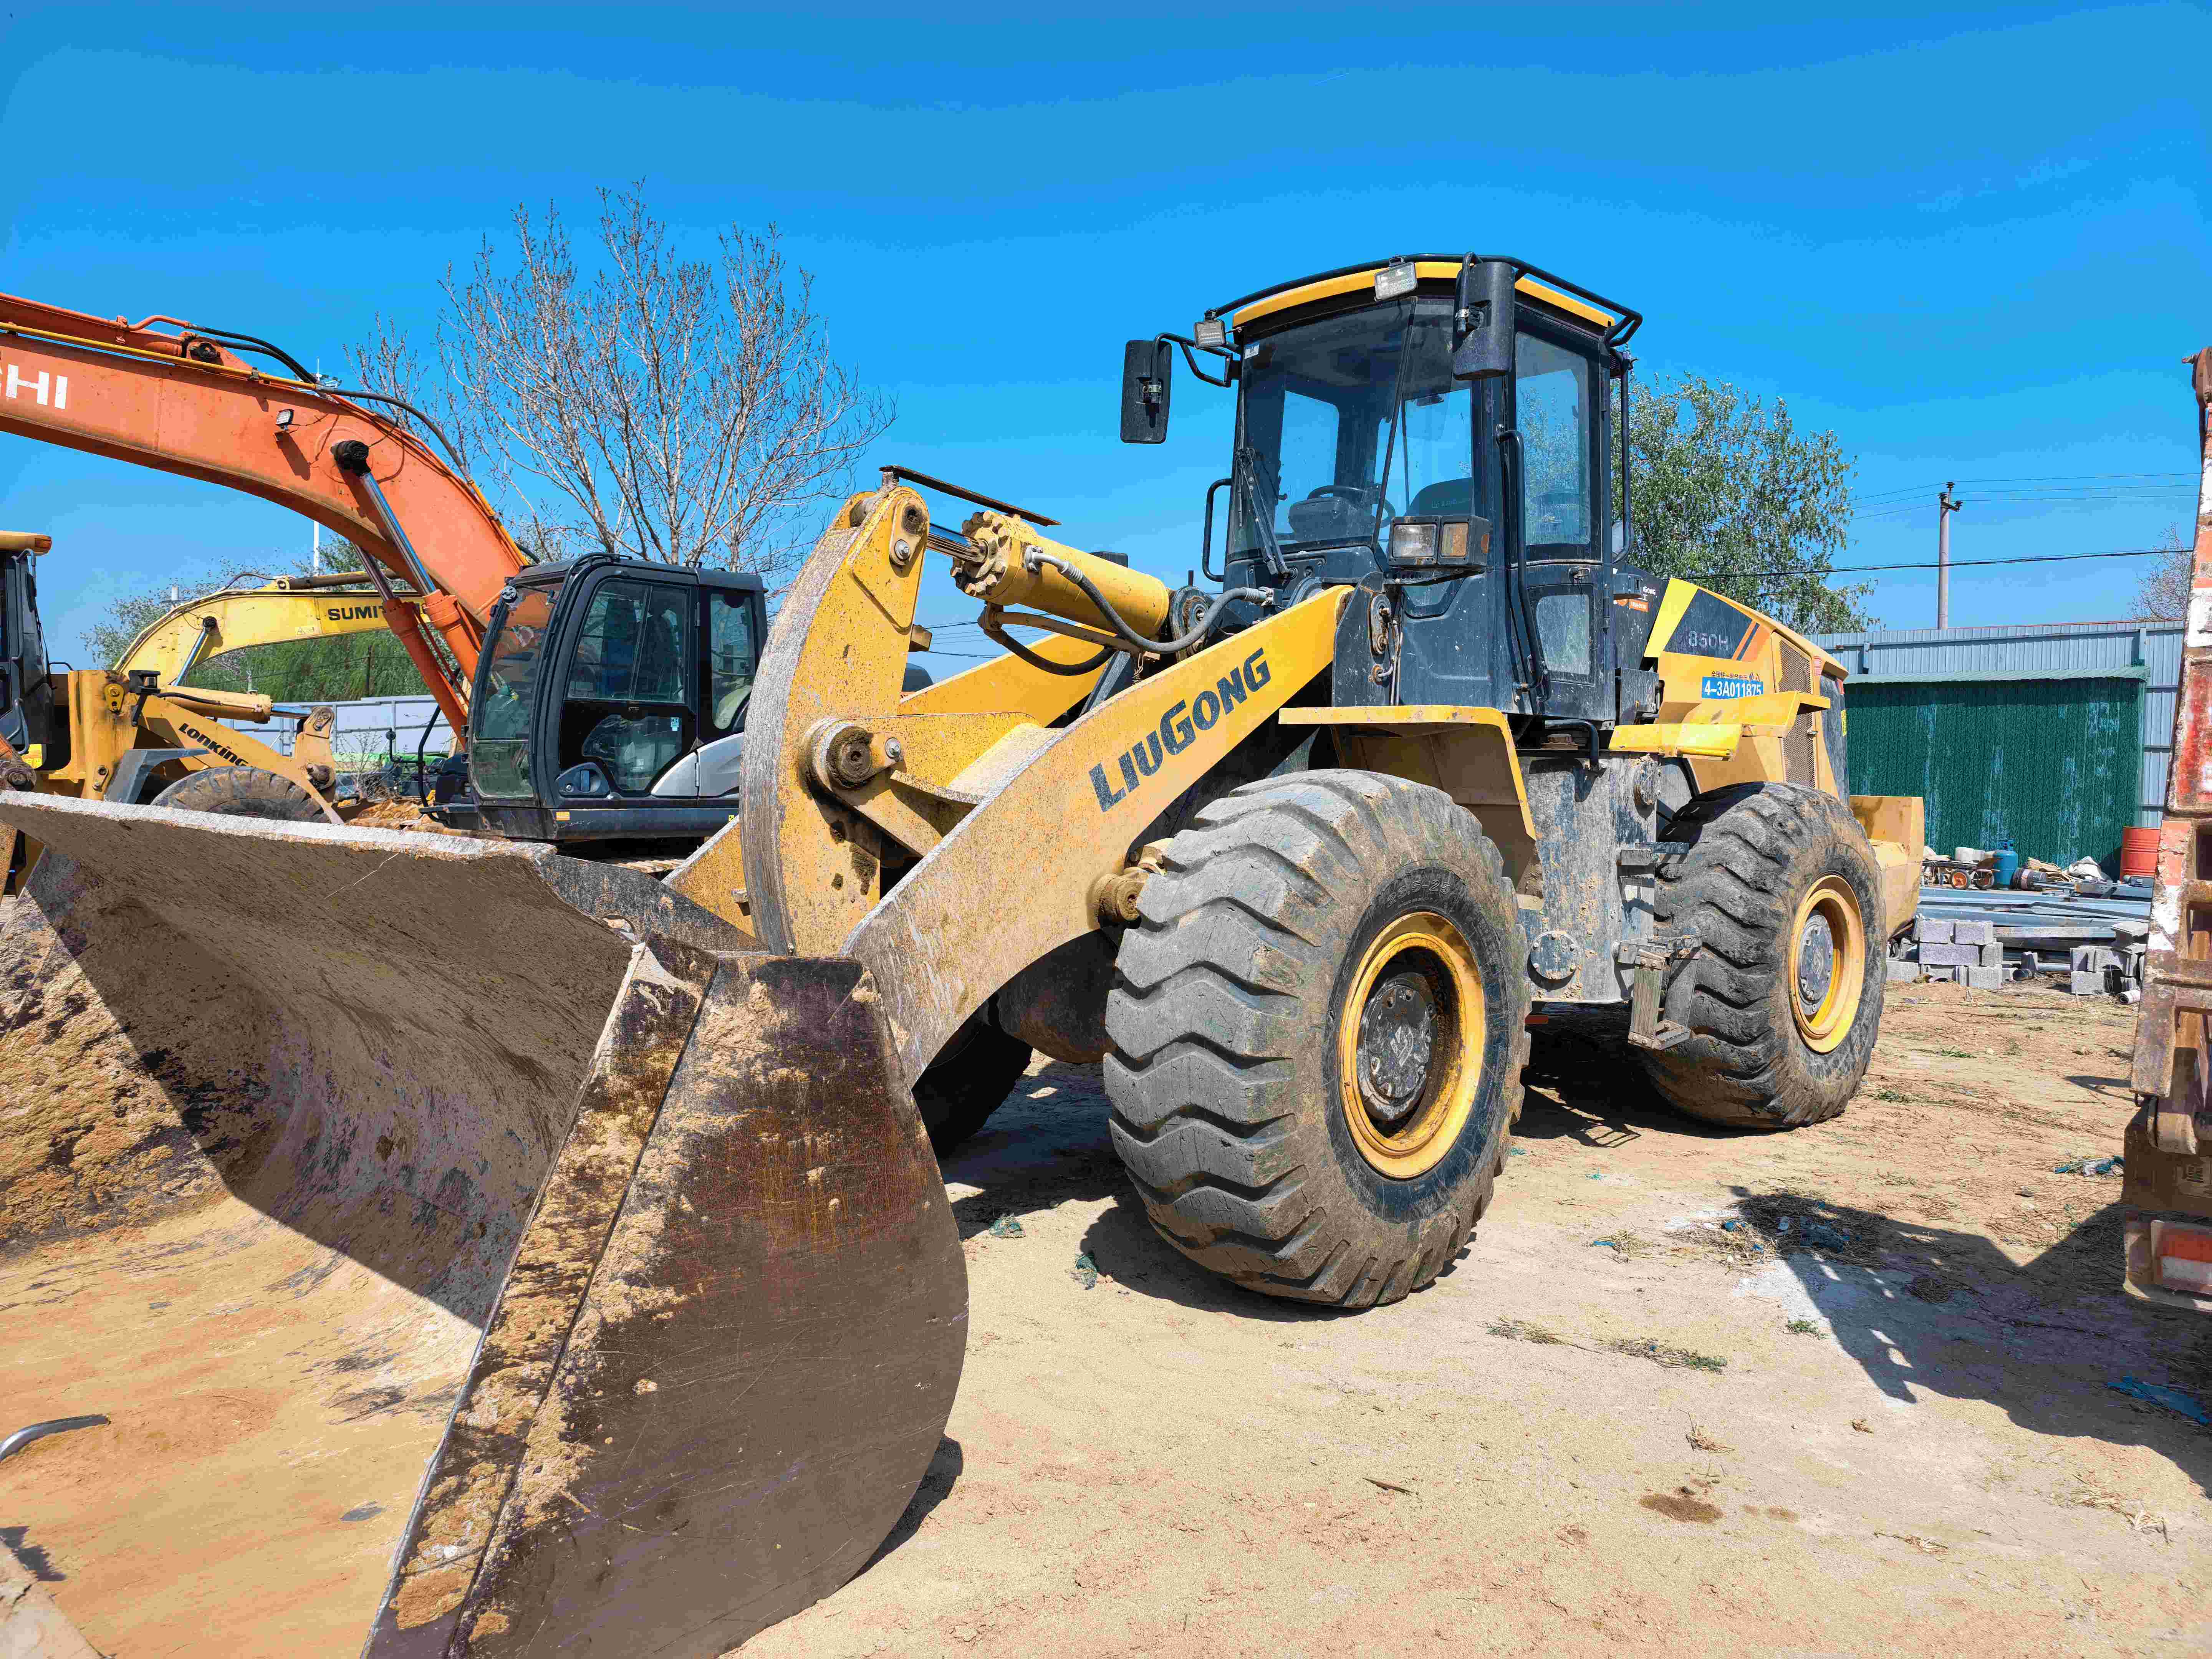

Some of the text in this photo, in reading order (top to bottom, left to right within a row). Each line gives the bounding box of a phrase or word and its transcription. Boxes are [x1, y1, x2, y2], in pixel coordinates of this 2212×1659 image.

[0, 364, 68, 410] HI
[1642, 586, 1656, 595] GONG
[1704, 680, 1762, 698] 4-3A011875
[1387, 879, 1450, 909] 23.5-25
